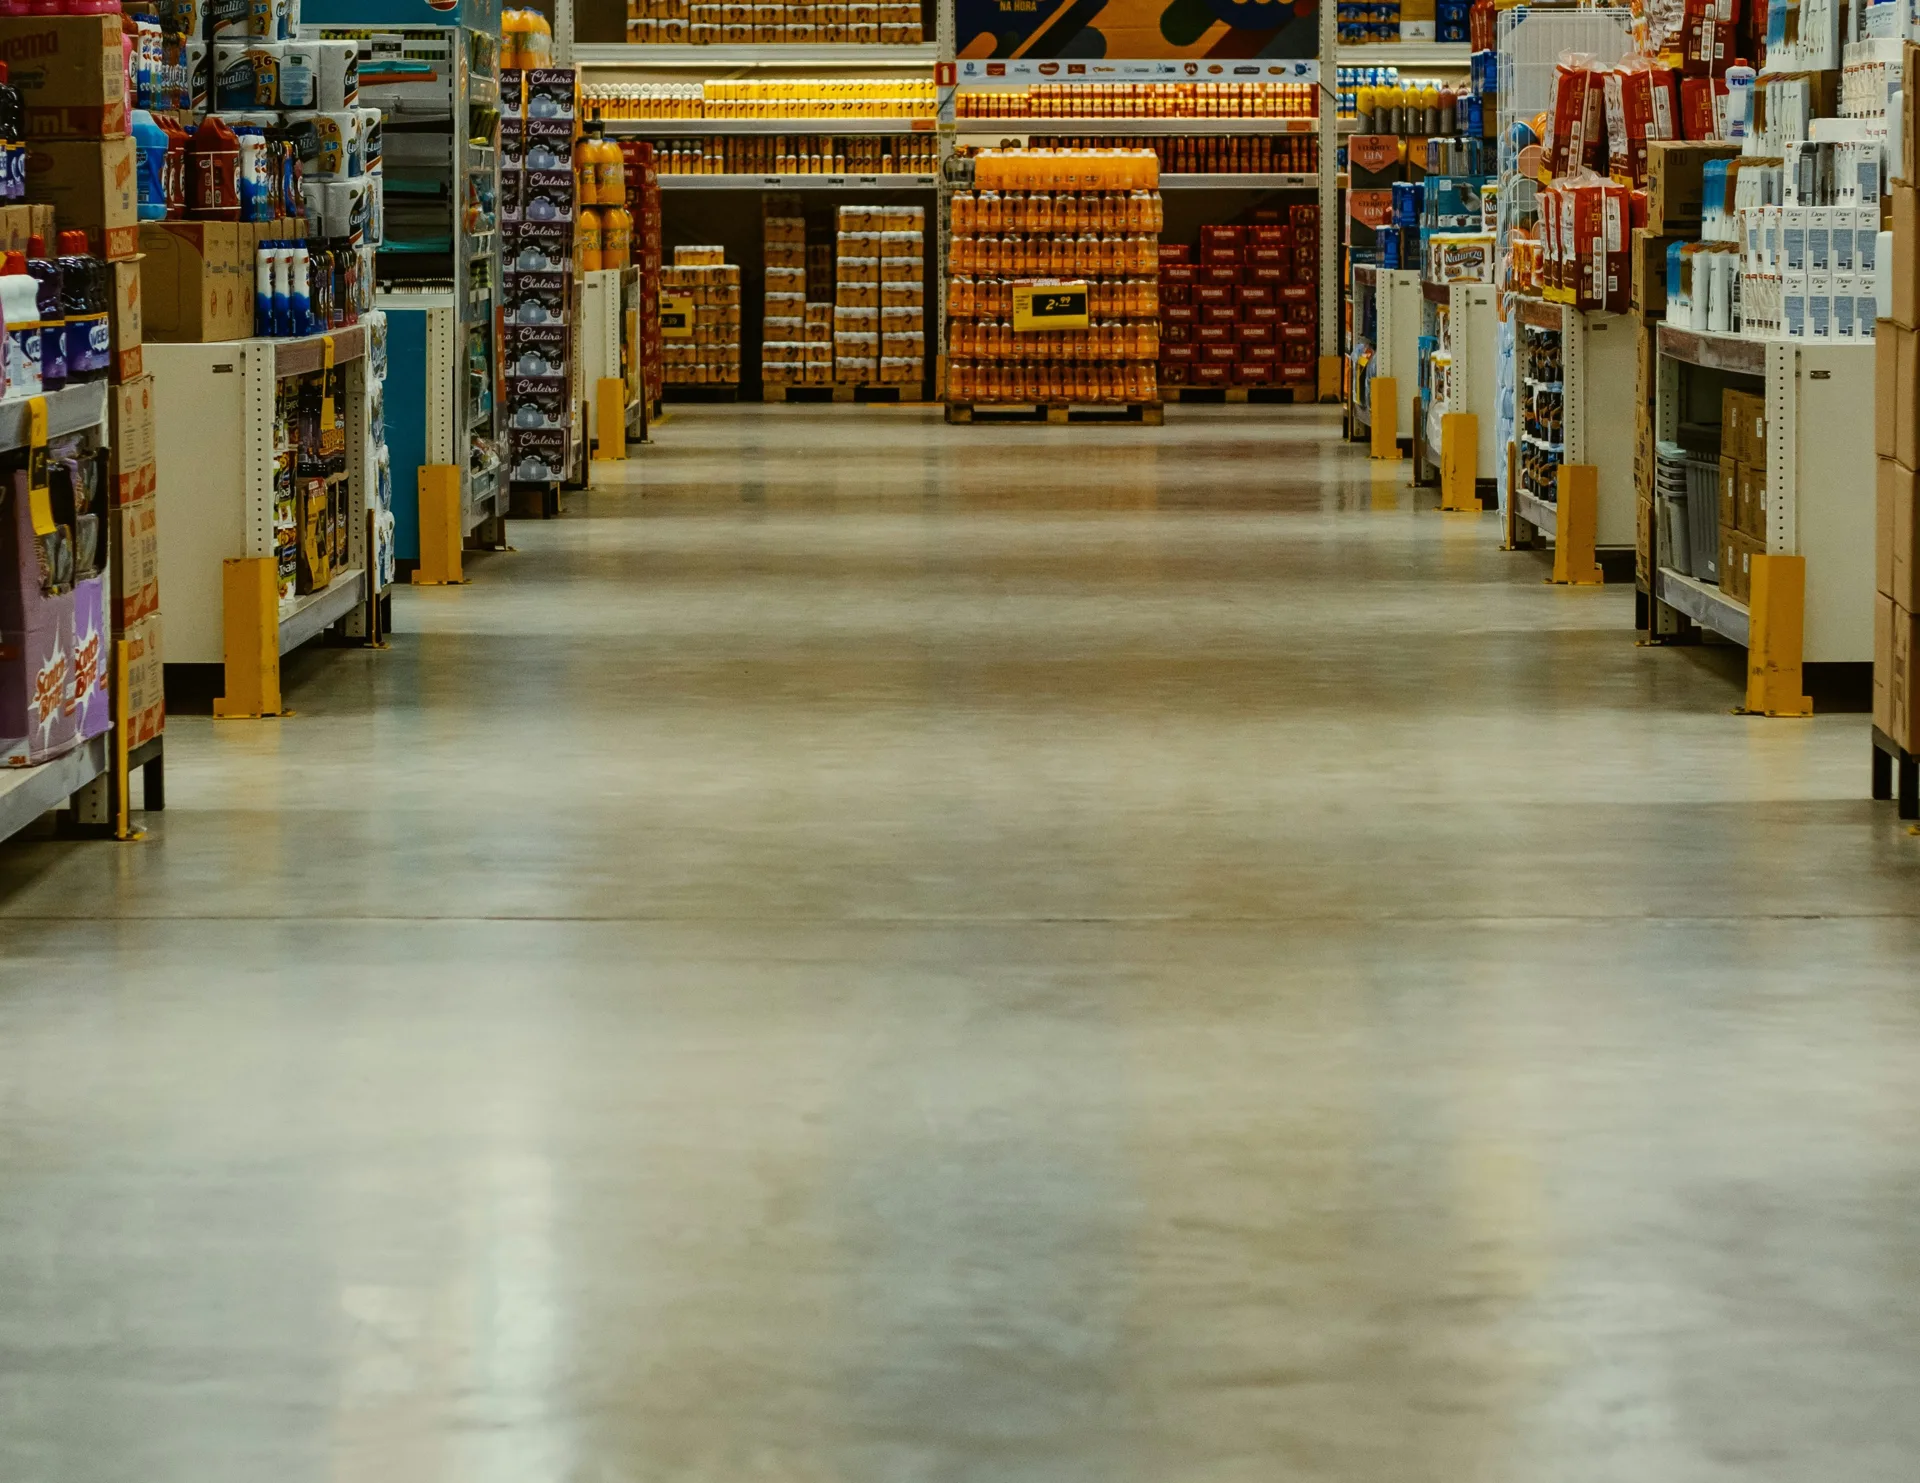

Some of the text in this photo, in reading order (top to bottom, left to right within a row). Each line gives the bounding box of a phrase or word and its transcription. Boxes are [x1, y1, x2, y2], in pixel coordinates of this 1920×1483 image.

[254, 4, 268, 14] 15
[1000, 2, 1036, 12] NA HORA
[252, 56, 272, 70] 16
[260, 74, 274, 85] 15
[531, 70, 572, 84] Chaleira
[318, 122, 337, 138] 16
[529, 121, 570, 136] Chaleira
[324, 141, 338, 152] 15
[530, 172, 571, 187] Chaleira
[518, 222, 562, 236] Chaleira
[1445, 251, 1482, 264] Natureza
[518, 275, 562, 290] Chaleira
[518, 327, 562, 342] Chaleira
[516, 379, 558, 394] Chaleira
[519, 432, 562, 446] Chaleira
[8, 755, 26, 764] 3M
